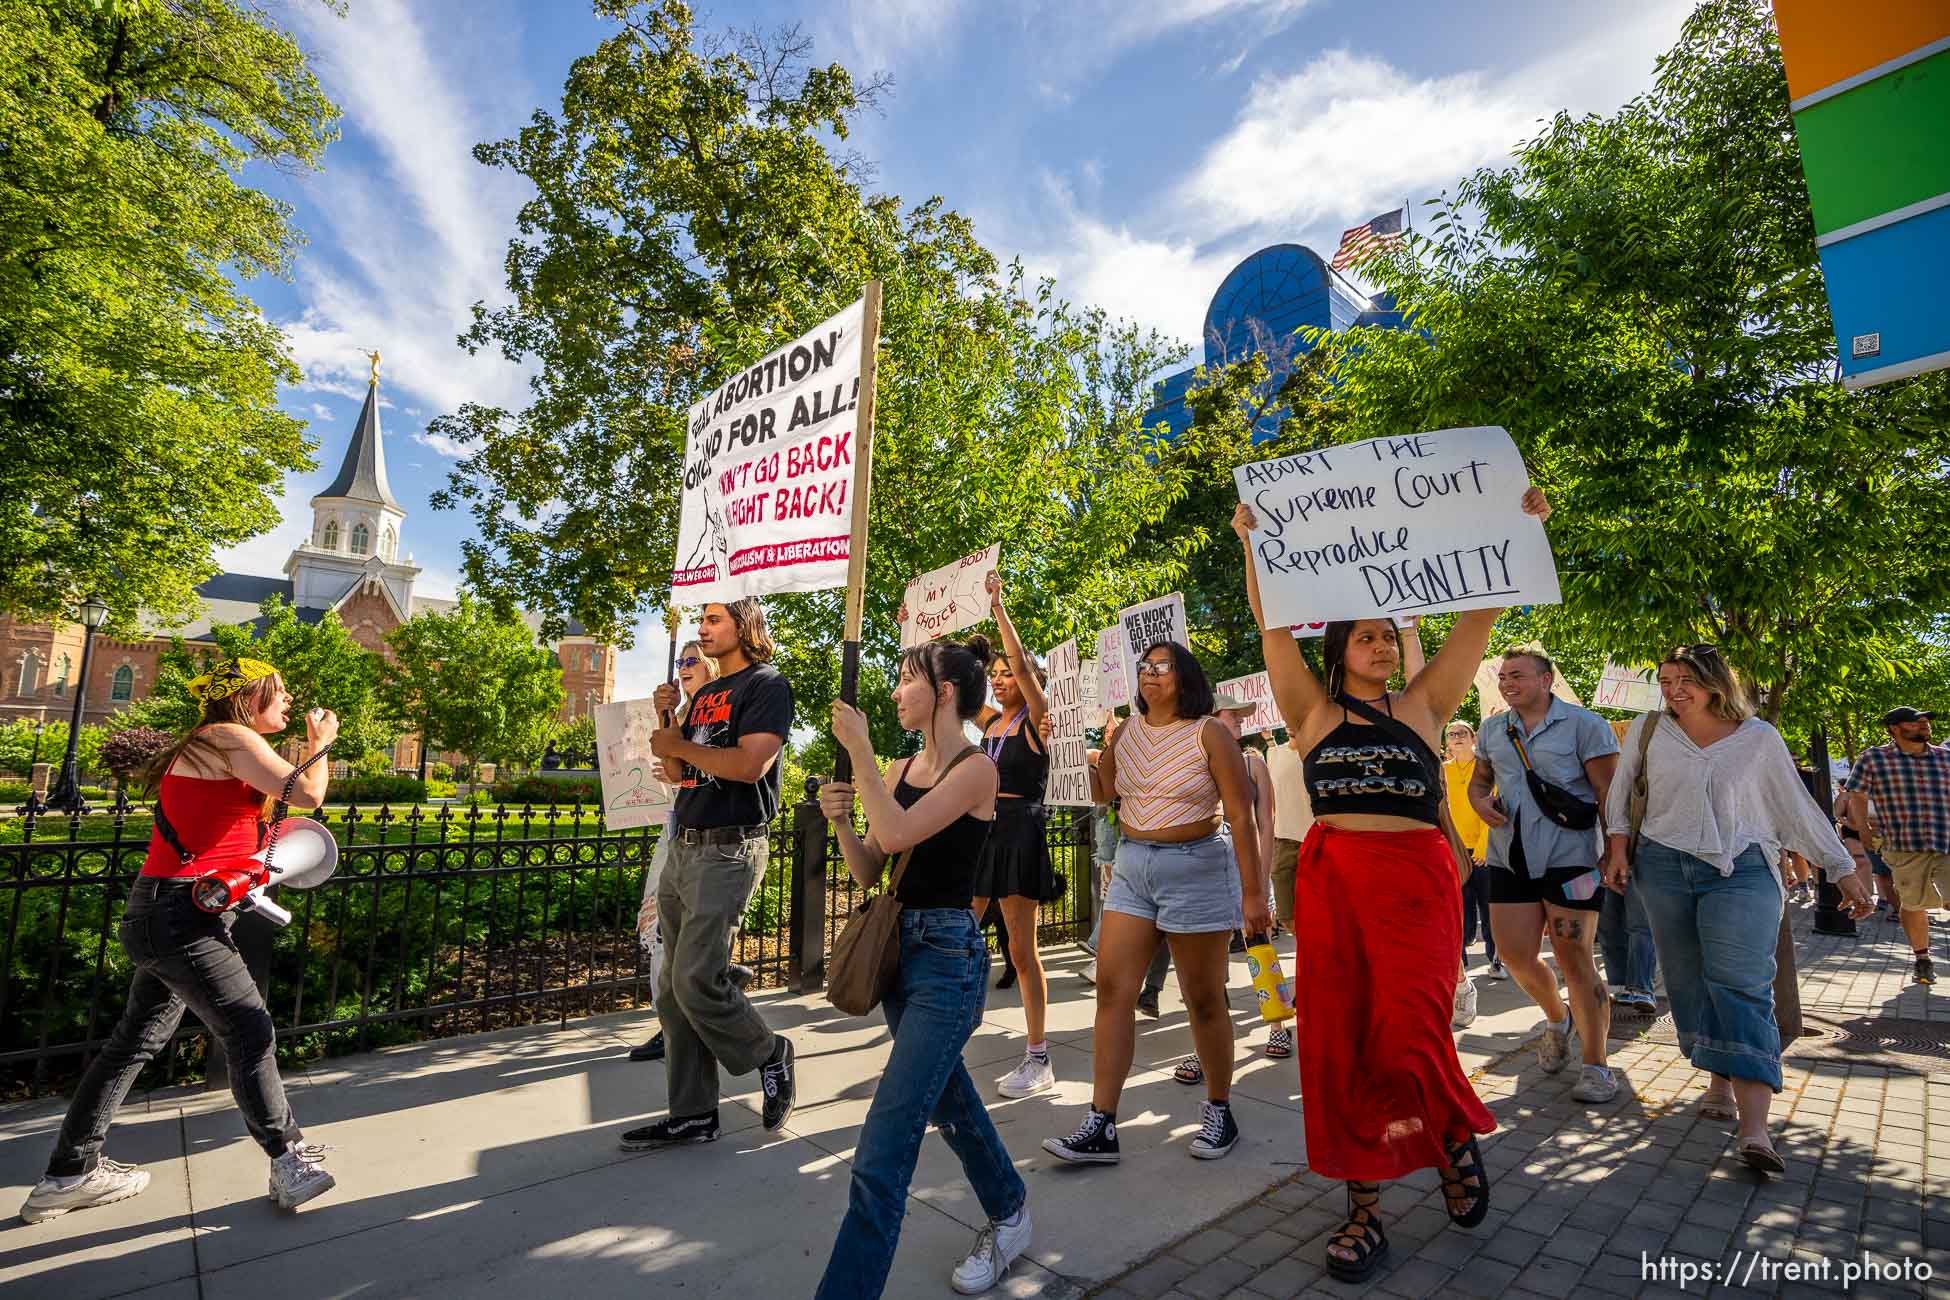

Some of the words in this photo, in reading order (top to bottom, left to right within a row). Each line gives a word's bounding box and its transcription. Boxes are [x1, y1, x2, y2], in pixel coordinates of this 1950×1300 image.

[728, 407, 777, 452] FOR
[787, 377, 859, 432] ALL!
[754, 451, 779, 484] GO
[786, 431, 851, 478] BACK
[1245, 451, 1332, 487] ABORT
[1350, 436, 1437, 463] THE
[775, 479, 847, 521] BACK!
[1255, 484, 1376, 538] Supreme
[1394, 460, 1490, 509] Court
[766, 546, 776, 562] &
[960, 547, 991, 569] BODY
[1258, 526, 1409, 576] Reproduce
[1359, 539, 1511, 608] DIGNITY
[926, 585, 947, 602] MY
[916, 600, 957, 629] CHOICE
[1125, 613, 1141, 629] WE
[1141, 604, 1174, 624] WON'T
[1130, 627, 1144, 641] GO
[1144, 618, 1174, 637] BACK
[1051, 772, 1091, 800] WOMEN
[1313, 776, 1426, 797] PROUD
